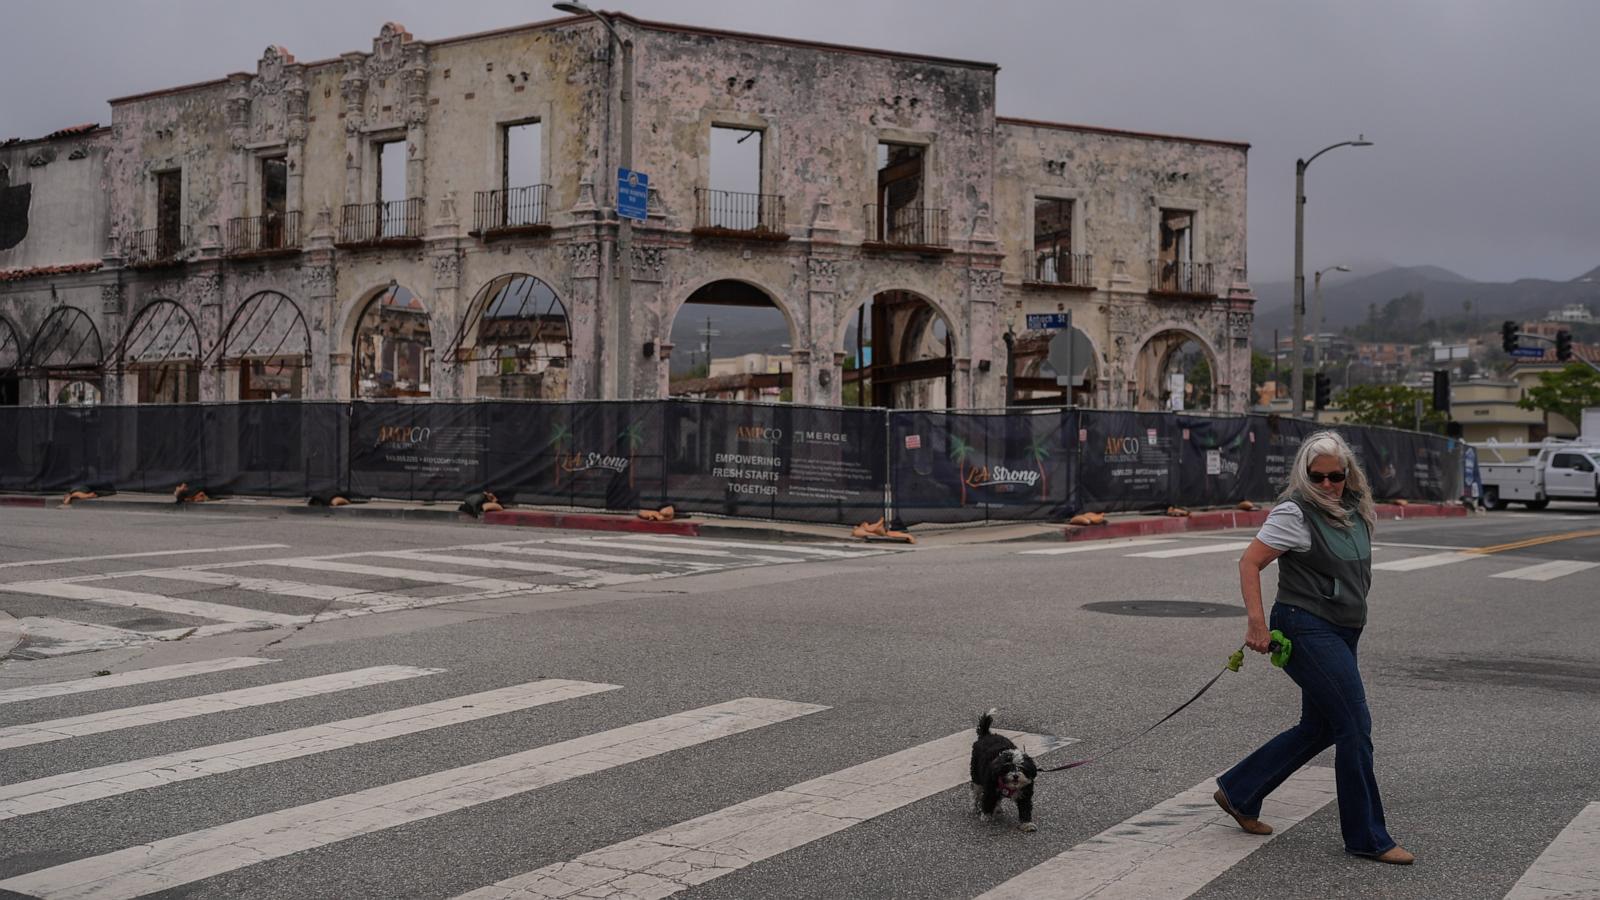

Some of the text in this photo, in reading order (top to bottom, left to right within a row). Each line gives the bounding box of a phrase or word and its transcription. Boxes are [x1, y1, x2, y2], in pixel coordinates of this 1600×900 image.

[736, 425, 782, 440] AMPCO
[806, 431, 848, 442] MERGE
[586, 451, 628, 473] Strong
[715, 453, 781, 467] EMPOWERING
[712, 468, 743, 479] FRESH
[744, 468, 779, 481] STARTS
[992, 465, 1040, 486] Strong
[728, 482, 778, 496] TOGETHER
